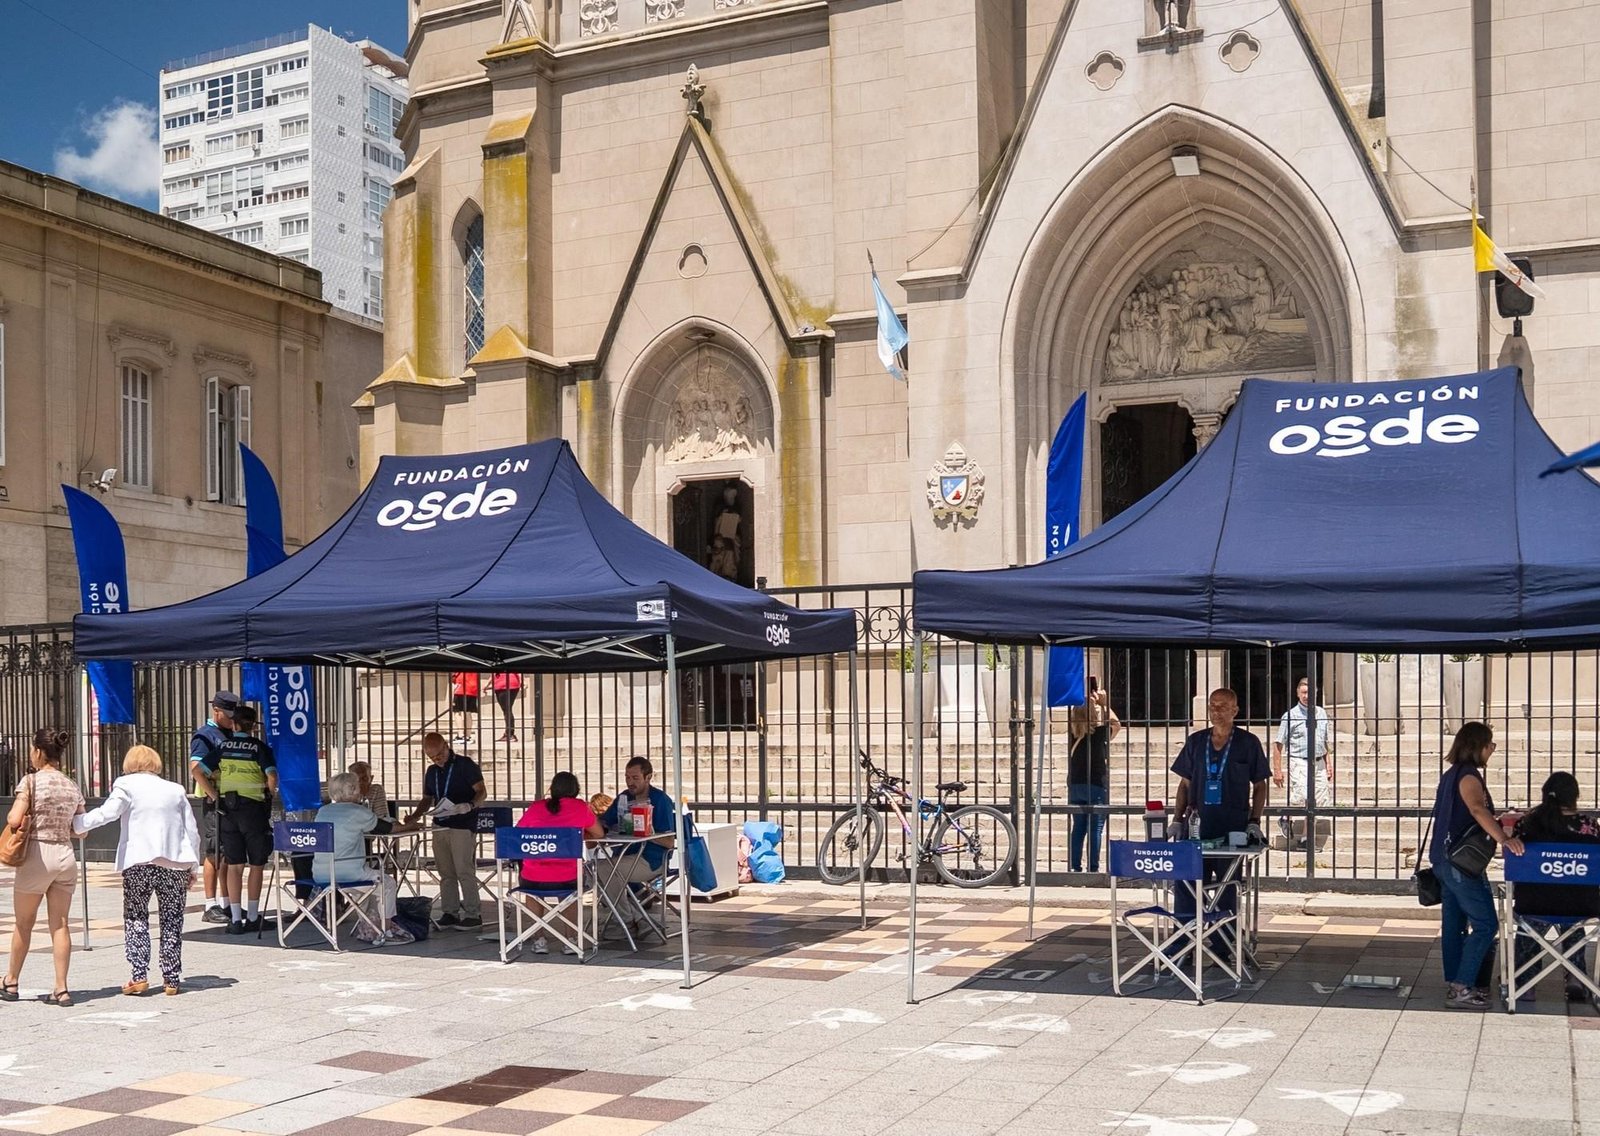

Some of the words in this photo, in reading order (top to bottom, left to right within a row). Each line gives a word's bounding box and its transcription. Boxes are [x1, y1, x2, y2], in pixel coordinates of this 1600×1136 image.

[1275, 385, 1480, 413] FUNDACIÓN
[1268, 406, 1480, 458] osde
[393, 458, 530, 486] FUNDACIÓN
[376, 481, 518, 532] osde
[765, 623, 790, 647] osde
[290, 834, 317, 848] osde
[521, 840, 557, 855] osde
[1133, 849, 1174, 857] FUNDACIÓN
[1541, 851, 1590, 860] FUNDACIÓN
[1134, 857, 1174, 874] osde
[1540, 860, 1589, 878] osde
